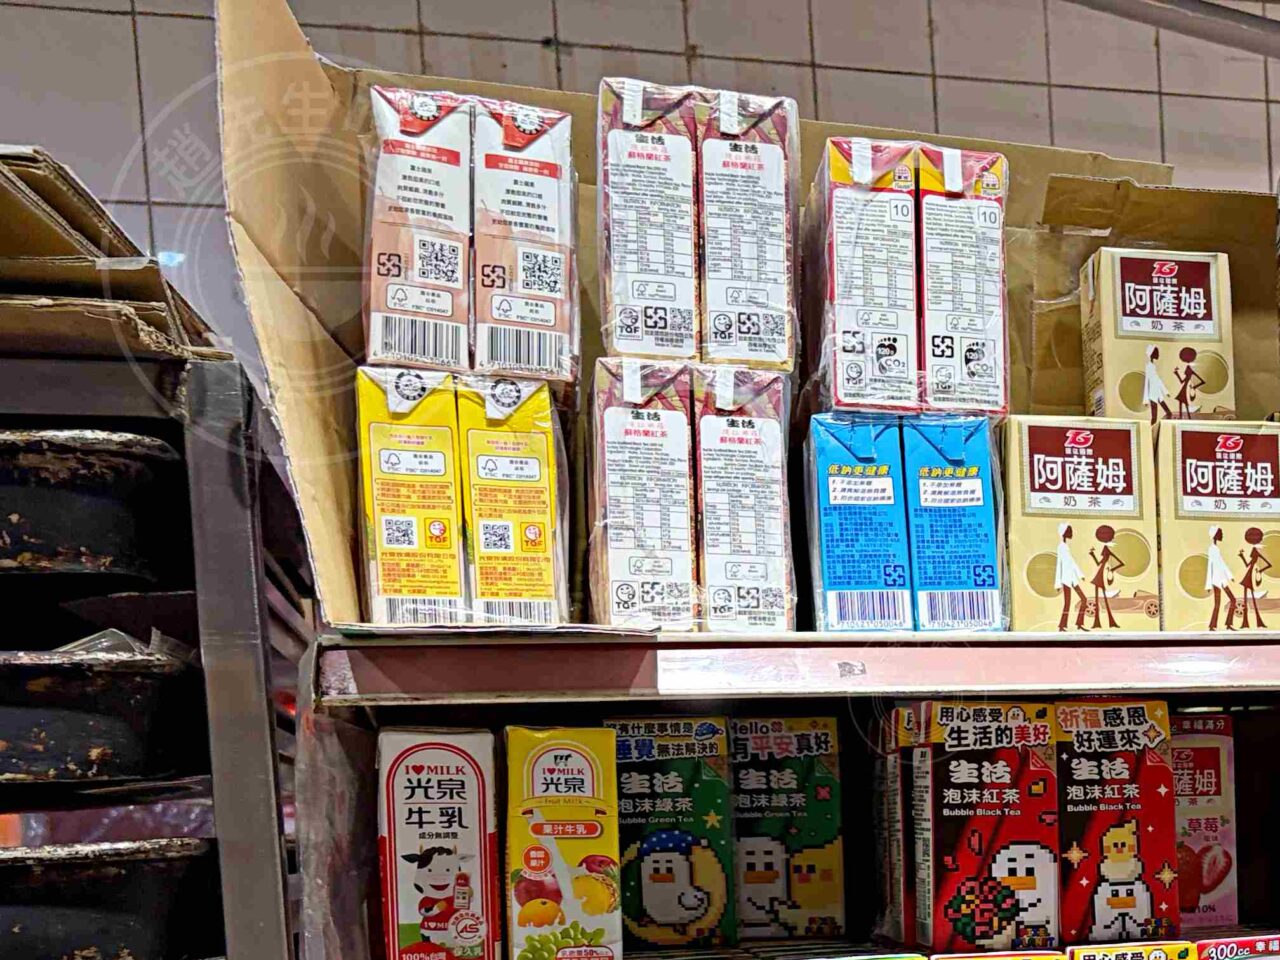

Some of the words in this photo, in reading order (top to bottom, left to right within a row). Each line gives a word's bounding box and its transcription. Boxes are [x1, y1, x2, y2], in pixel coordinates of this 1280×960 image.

[893, 205, 909, 217] 10
[981, 211, 997, 224] 10
[1125, 283, 1206, 318] 阿薩姆
[1151, 320, 1185, 331] 奶茶
[1034, 454, 1127, 493] 阿薩姆
[1185, 459, 1274, 496] 阿薩姆
[1064, 495, 1102, 508] 奶茶
[1213, 498, 1251, 511] 奶茶
[1059, 707, 1150, 728] 祈福感恩
[1075, 729, 1142, 750] 好運來
[429, 765, 466, 776] MILK
[404, 778, 468, 800] 光泉
[943, 789, 1020, 804] 泡沫紅茶
[406, 807, 469, 829] 牛乳
